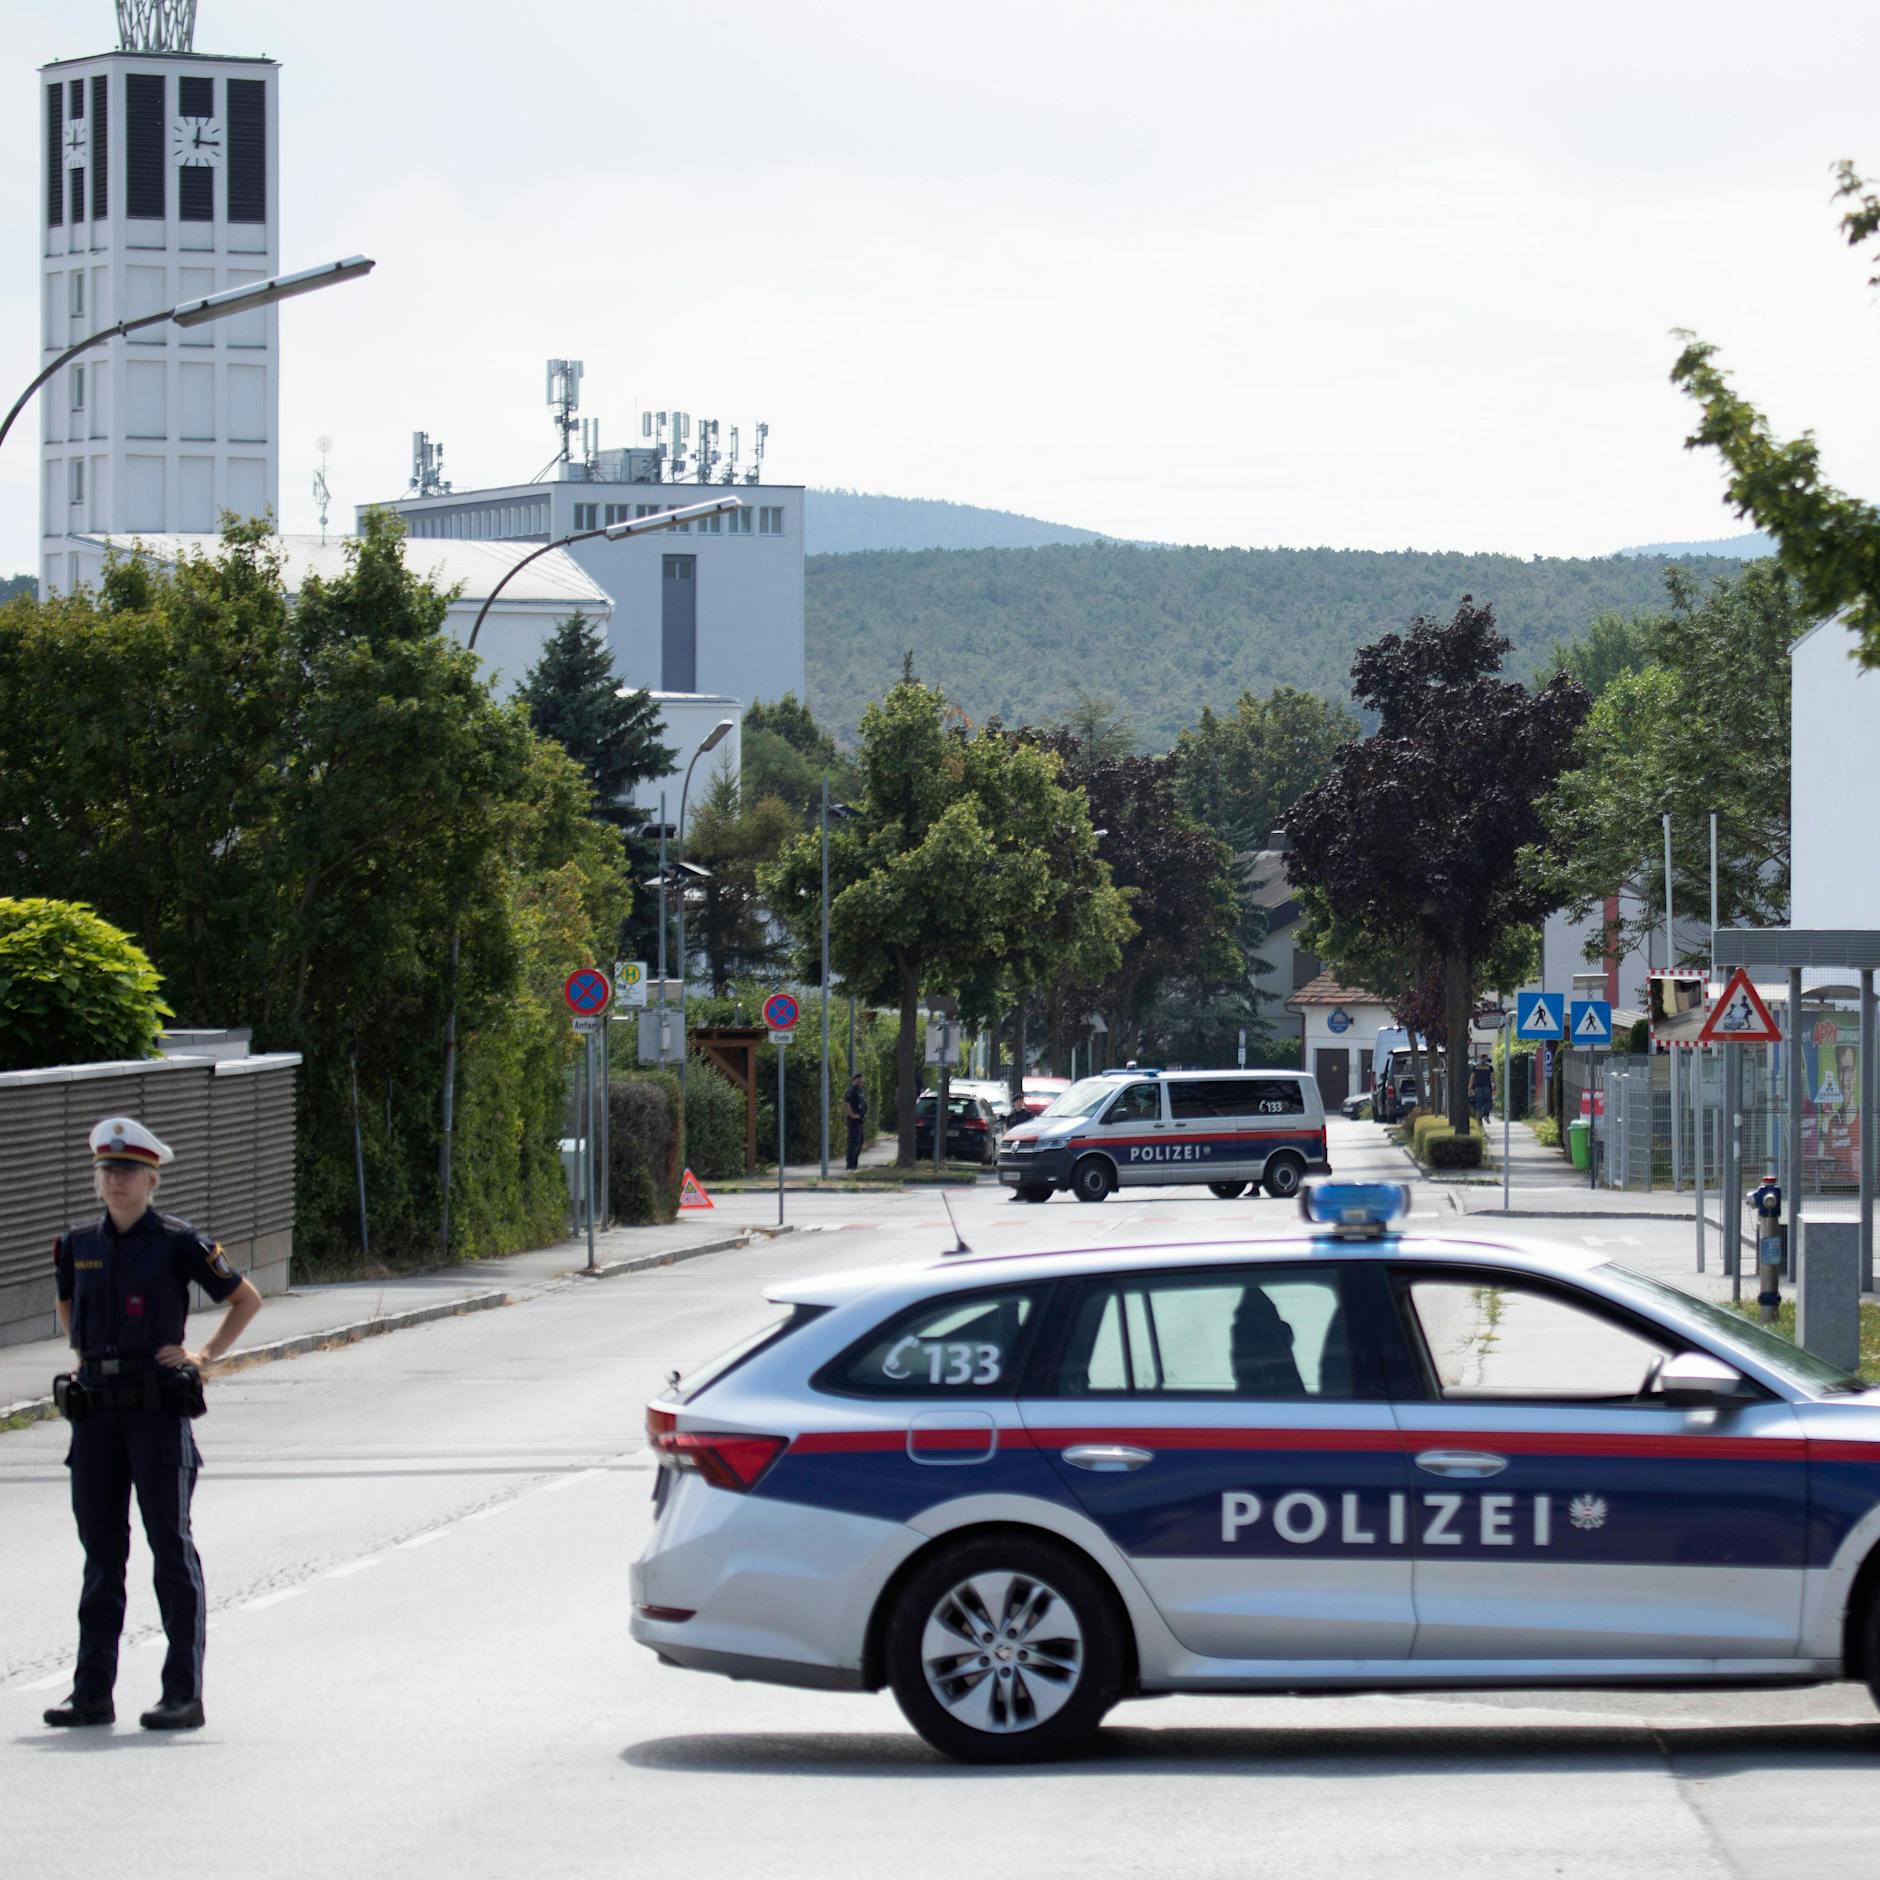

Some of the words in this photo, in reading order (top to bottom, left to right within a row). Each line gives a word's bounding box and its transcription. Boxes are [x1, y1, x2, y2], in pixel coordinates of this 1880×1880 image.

[625, 968, 635, 979] H
[1266, 1101, 1283, 1113] 133
[1130, 1145, 1200, 1161] POLIZEI
[923, 1343, 1001, 1386] 133
[1220, 1491, 1551, 1547] POLIZEI
